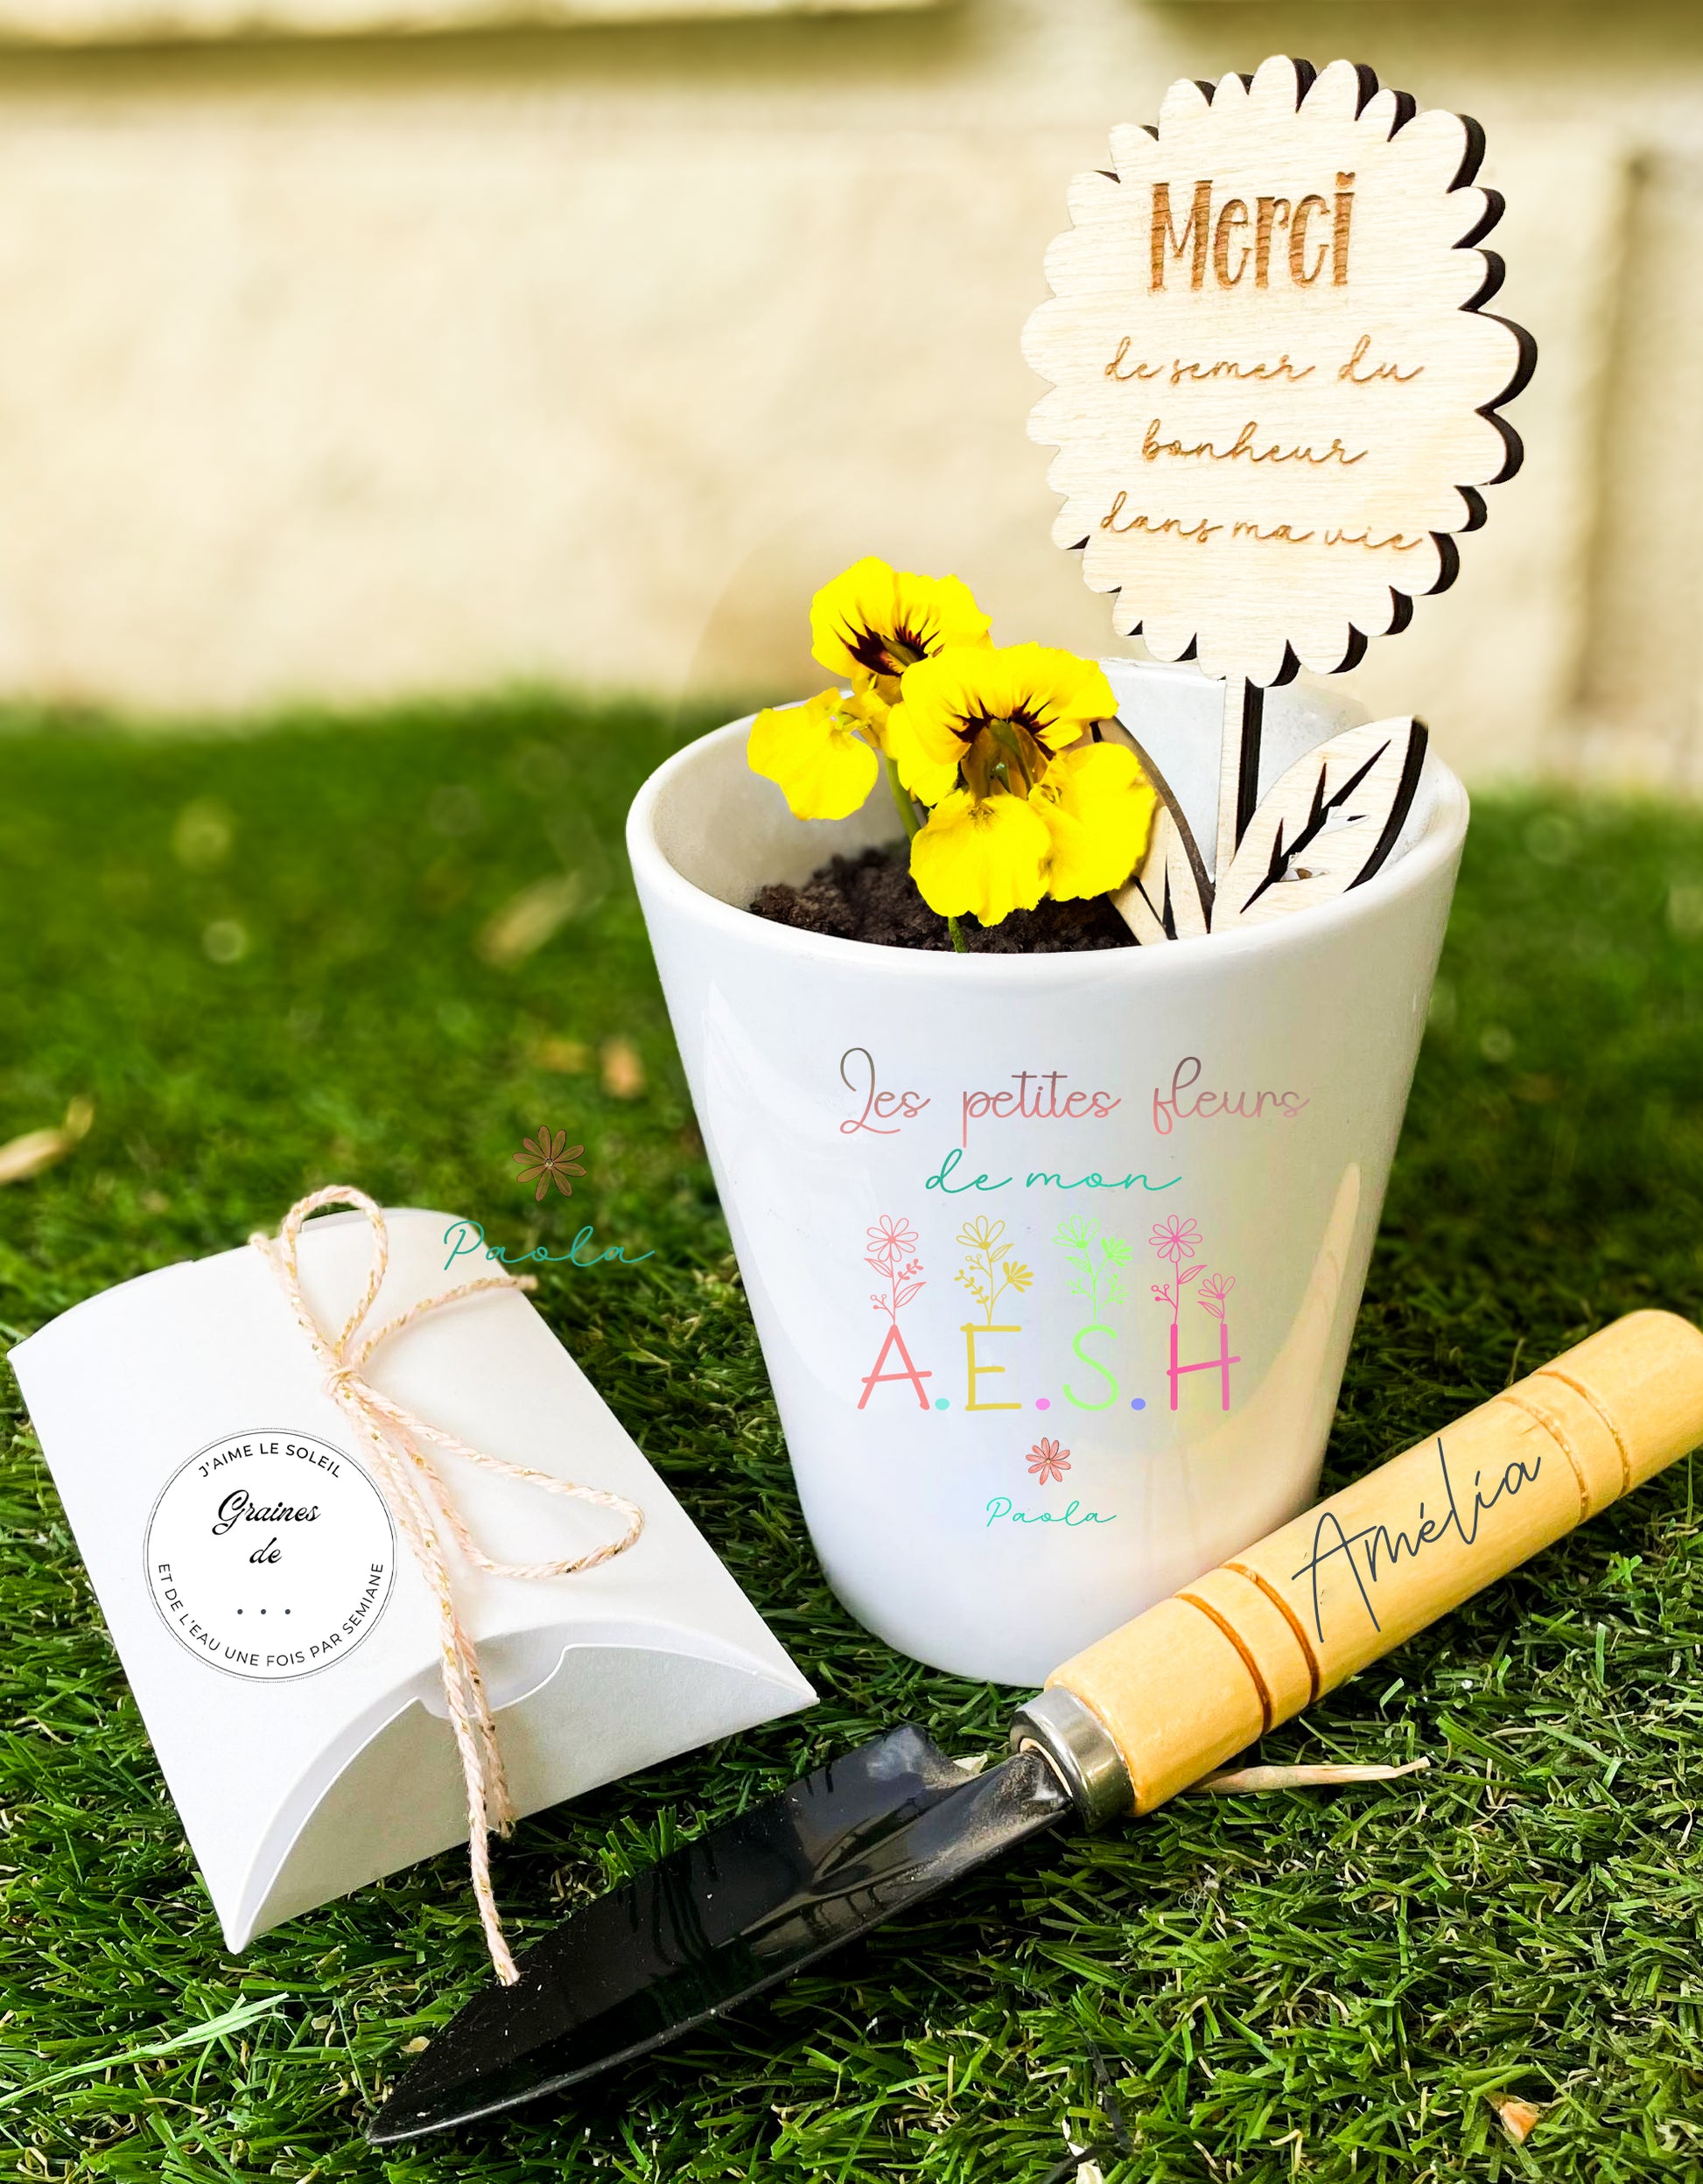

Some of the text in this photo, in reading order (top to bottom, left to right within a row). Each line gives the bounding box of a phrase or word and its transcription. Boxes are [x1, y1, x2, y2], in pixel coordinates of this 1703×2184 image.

[1147, 172, 1356, 293] Merci
[1104, 334, 1426, 384] de semer du
[1140, 419, 1369, 464] bonheur
[1100, 491, 1423, 551] dans ma vie
[839, 1047, 1311, 1148] Les petites fleurs
[925, 1148, 1182, 1194] de mon
[858, 1322, 1241, 1411] A.E.S.H
[199, 1443, 341, 1478] J'AIME LE SOLEIL
[212, 1489, 321, 1535] Graines
[985, 1496, 1117, 1527] Paola
[249, 1537, 282, 1564] de
[1292, 1437, 1541, 1643] Amélia
[158, 1563, 383, 1667] ET DE L'EAU UNE FOIS PAR SEMIANE
